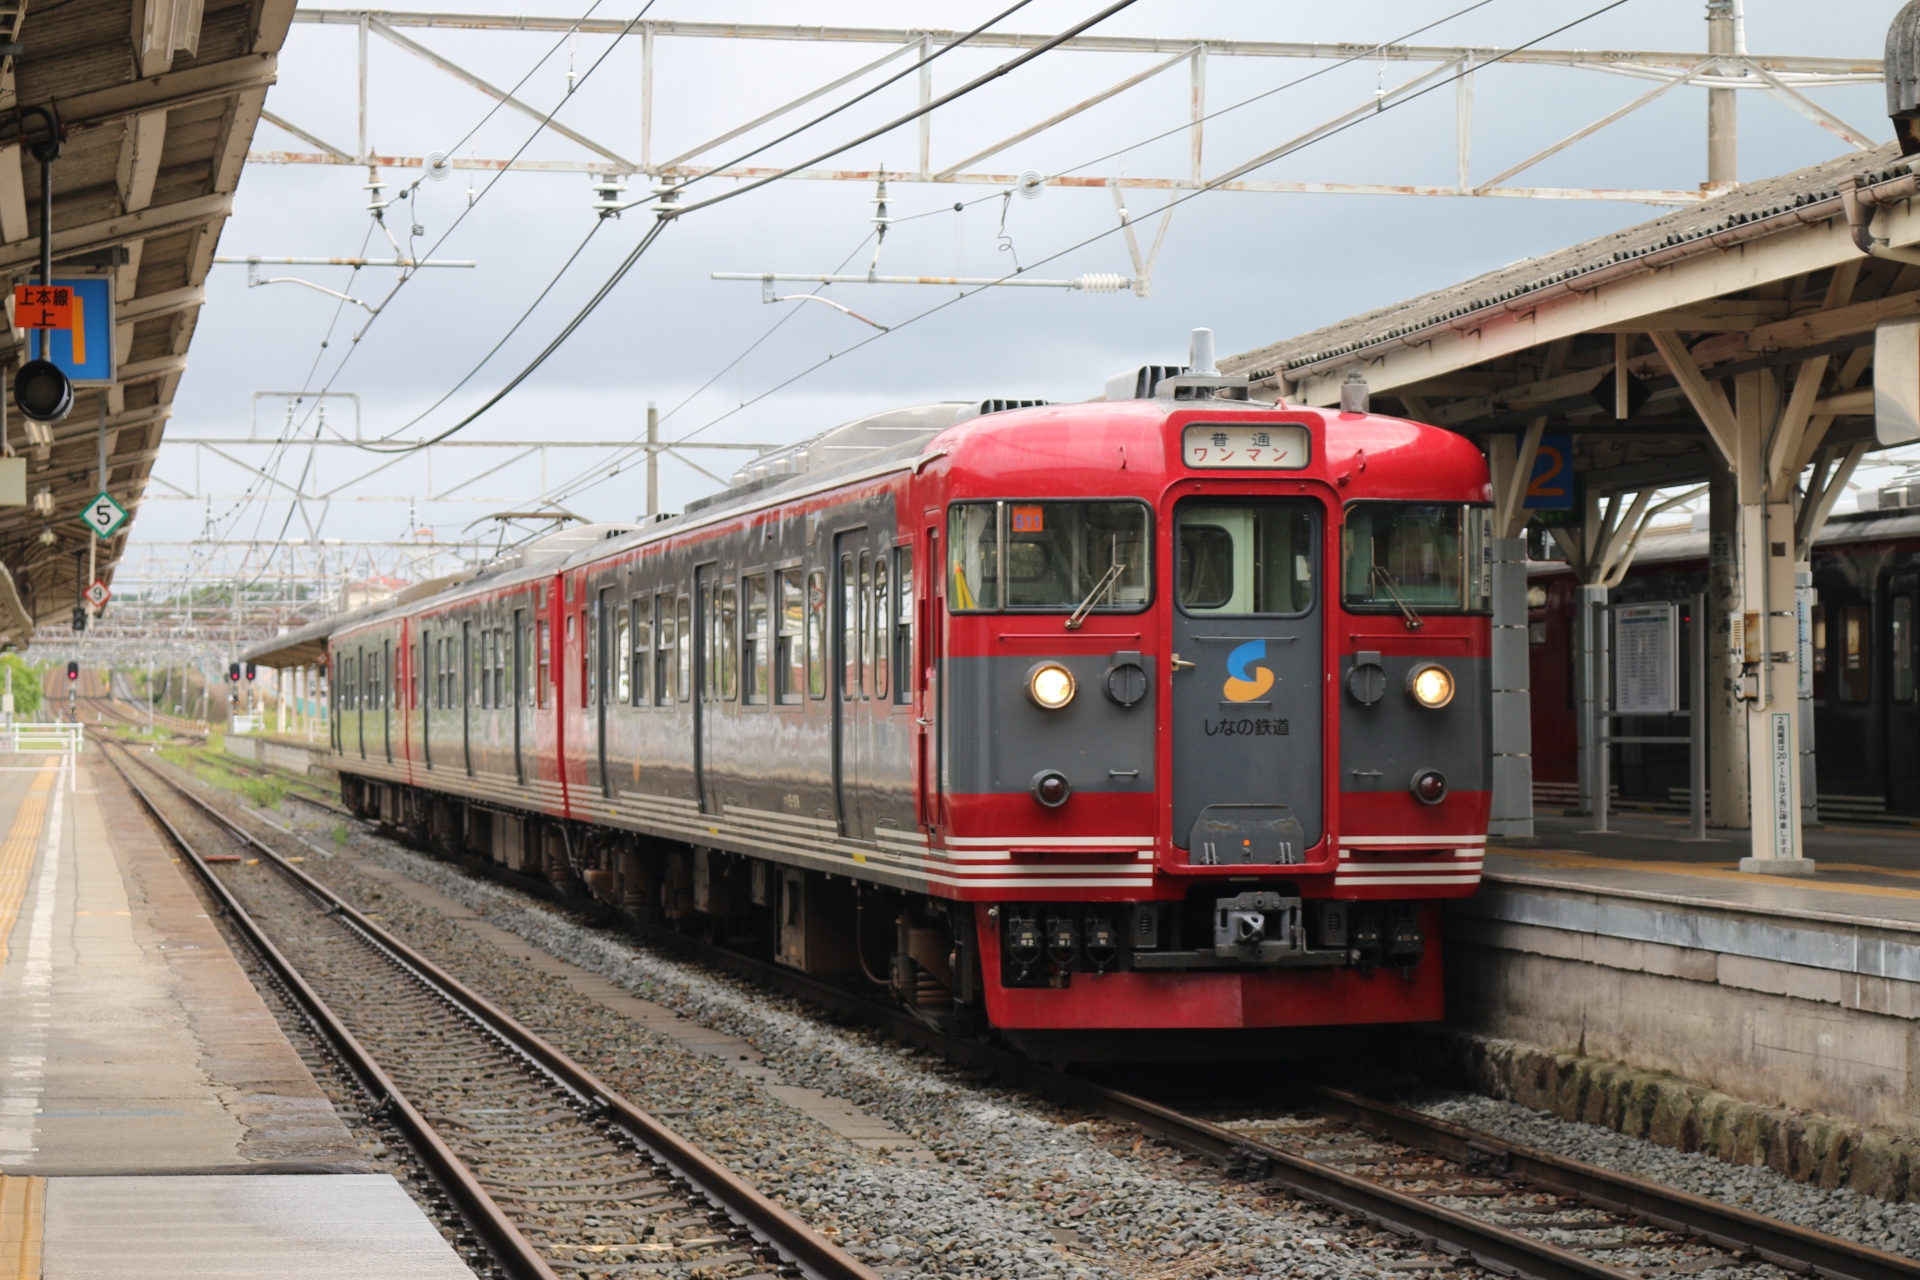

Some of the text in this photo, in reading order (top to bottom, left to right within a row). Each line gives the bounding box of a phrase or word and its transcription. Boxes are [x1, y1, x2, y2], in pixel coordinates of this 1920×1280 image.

[18, 287, 69, 307] 上本線
[32, 308, 57, 327] 上
[1210, 432, 1271, 447] 普通
[1193, 447, 1288, 462] ワンマン
[1526, 445, 1565, 496] 2
[96, 505, 111, 525] 5
[1015, 514, 1041, 529] S11
[93, 587, 102, 600] 9
[1204, 718, 1290, 737] しなの鉄道
